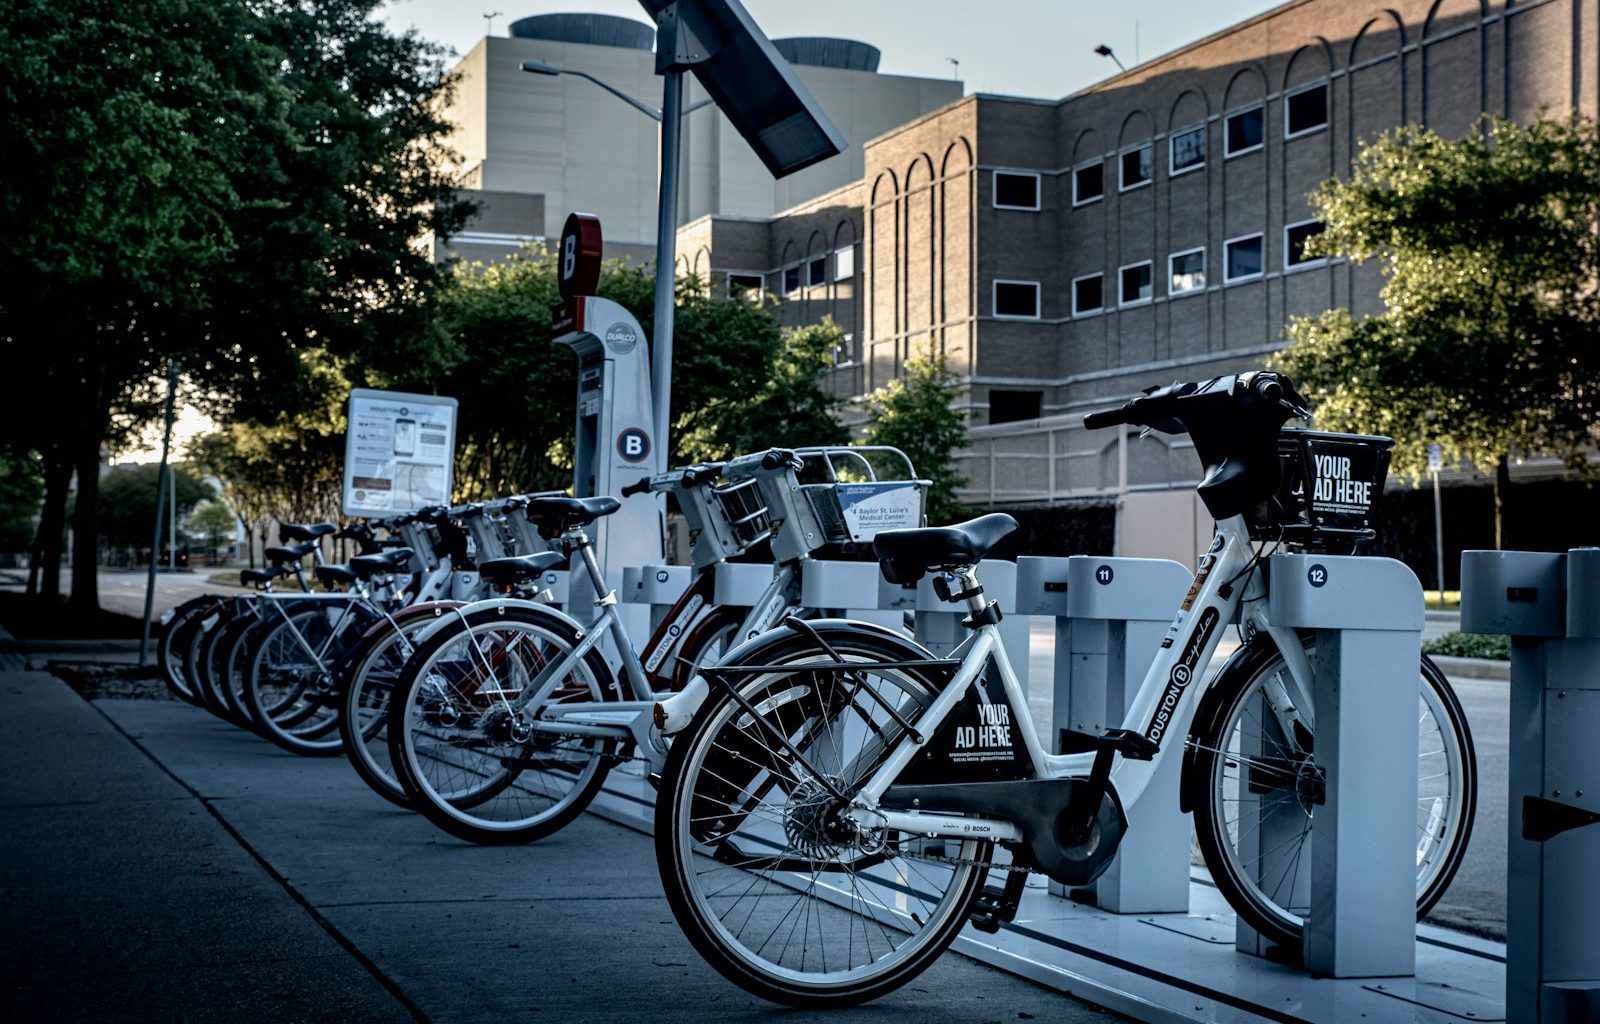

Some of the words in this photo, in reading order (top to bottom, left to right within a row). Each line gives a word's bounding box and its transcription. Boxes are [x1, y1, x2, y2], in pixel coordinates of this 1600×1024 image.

[564, 234, 576, 280] B
[626, 435, 642, 455] B
[1314, 454, 1351, 480] YOUR
[1313, 478, 1333, 501] AD
[1335, 480, 1371, 505] HERE
[859, 507, 879, 516] Baylor
[884, 513, 905, 521] Center
[1099, 569, 1109, 581] 11
[1311, 569, 1324, 582] 12
[1186, 612, 1215, 665] cycle
[646, 635, 673, 670] HOUSTON
[977, 703, 1010, 725] YOUR
[955, 726, 975, 748] AD
[979, 726, 1013, 748] HERE
